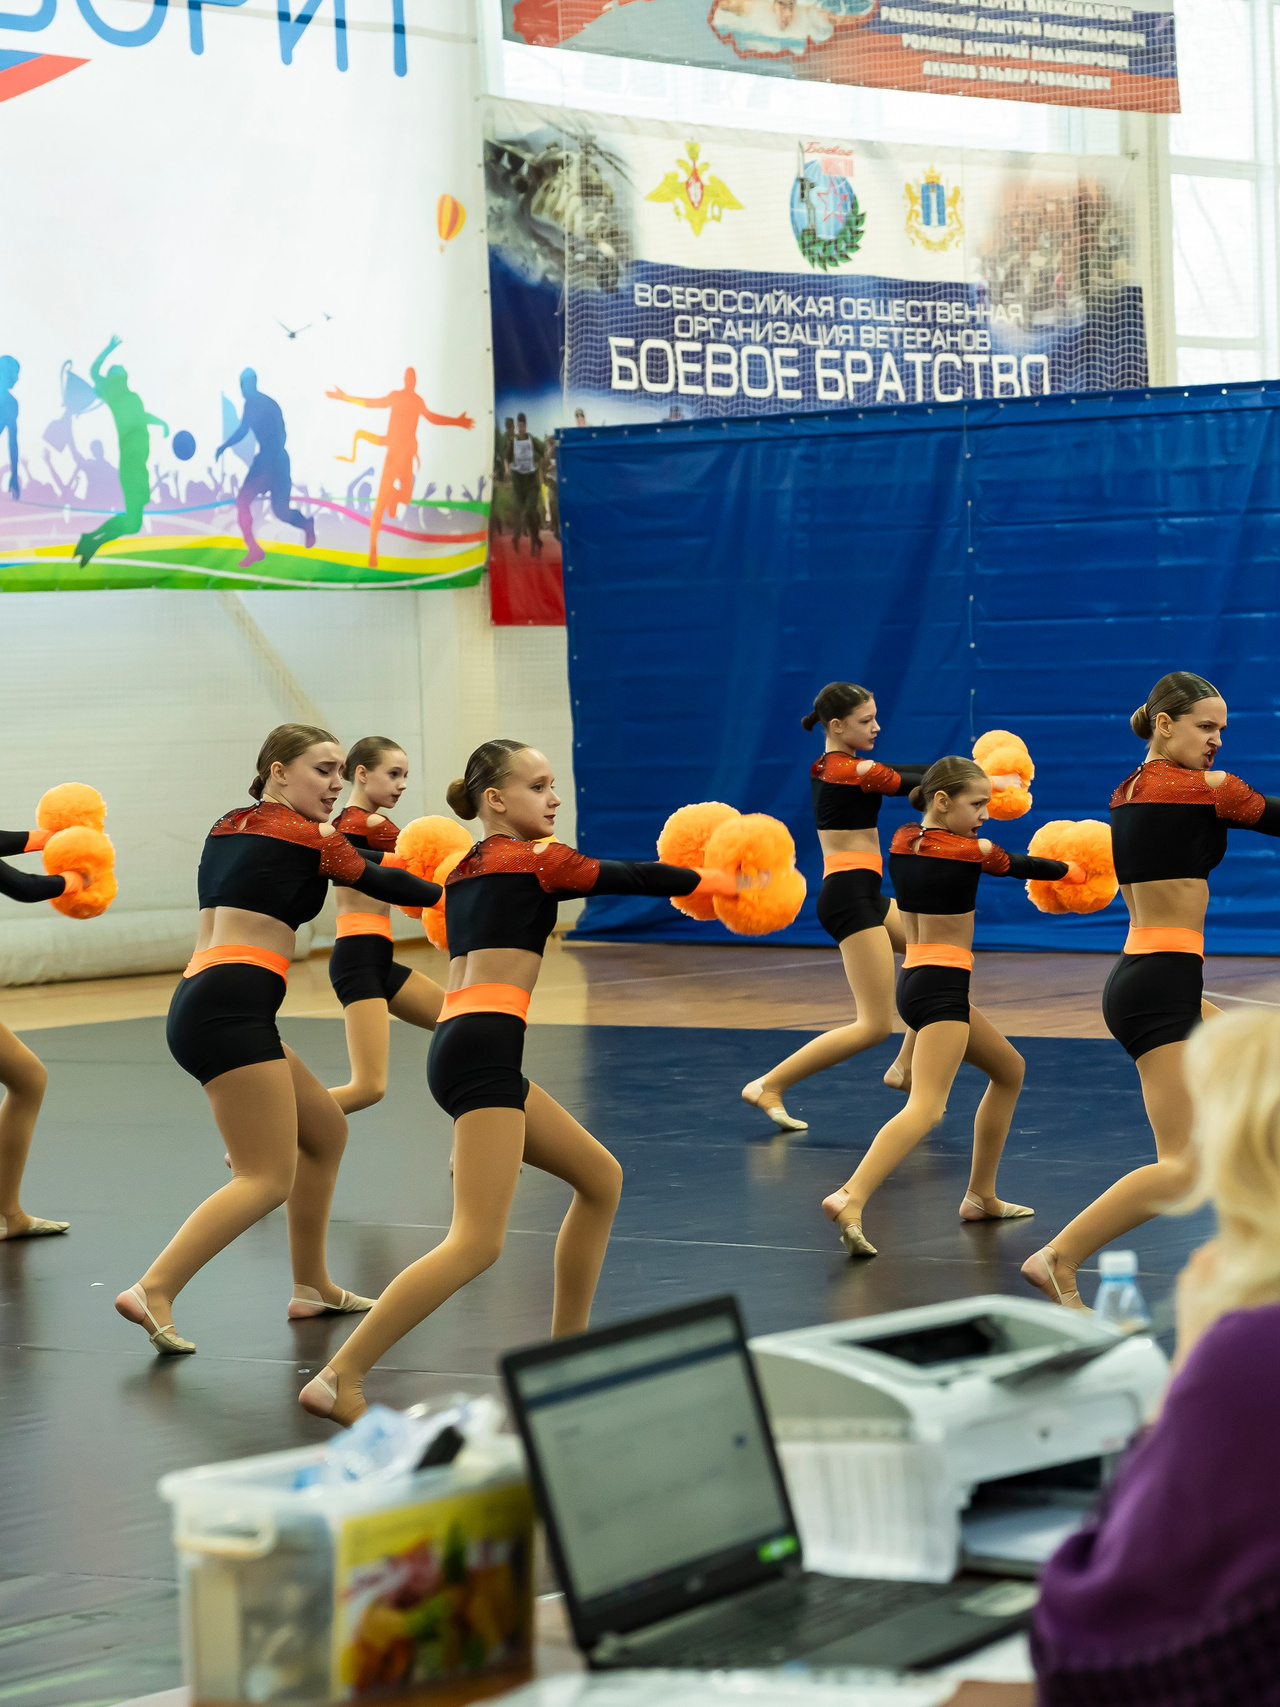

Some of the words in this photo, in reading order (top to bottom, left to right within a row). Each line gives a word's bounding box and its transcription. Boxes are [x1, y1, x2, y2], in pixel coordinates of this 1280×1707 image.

[977, 17, 1042, 37] ДМИТРИЙ
[901, 33, 962, 54] РОМАНОВ
[963, 40, 1029, 59] ДМИТРИЙ
[634, 283, 835, 318] ВСЕРОССИЙКАЯ
[839, 297, 1025, 325] ОБЩЕСТВЕННАЯ
[674, 315, 854, 349] ОРГАНИЗАЦИЯ
[860, 325, 991, 351] ВЕТЕРАНОВ
[608, 336, 803, 399] БОЕВОЕ
[814, 349, 1051, 402] БРАТСТВО
